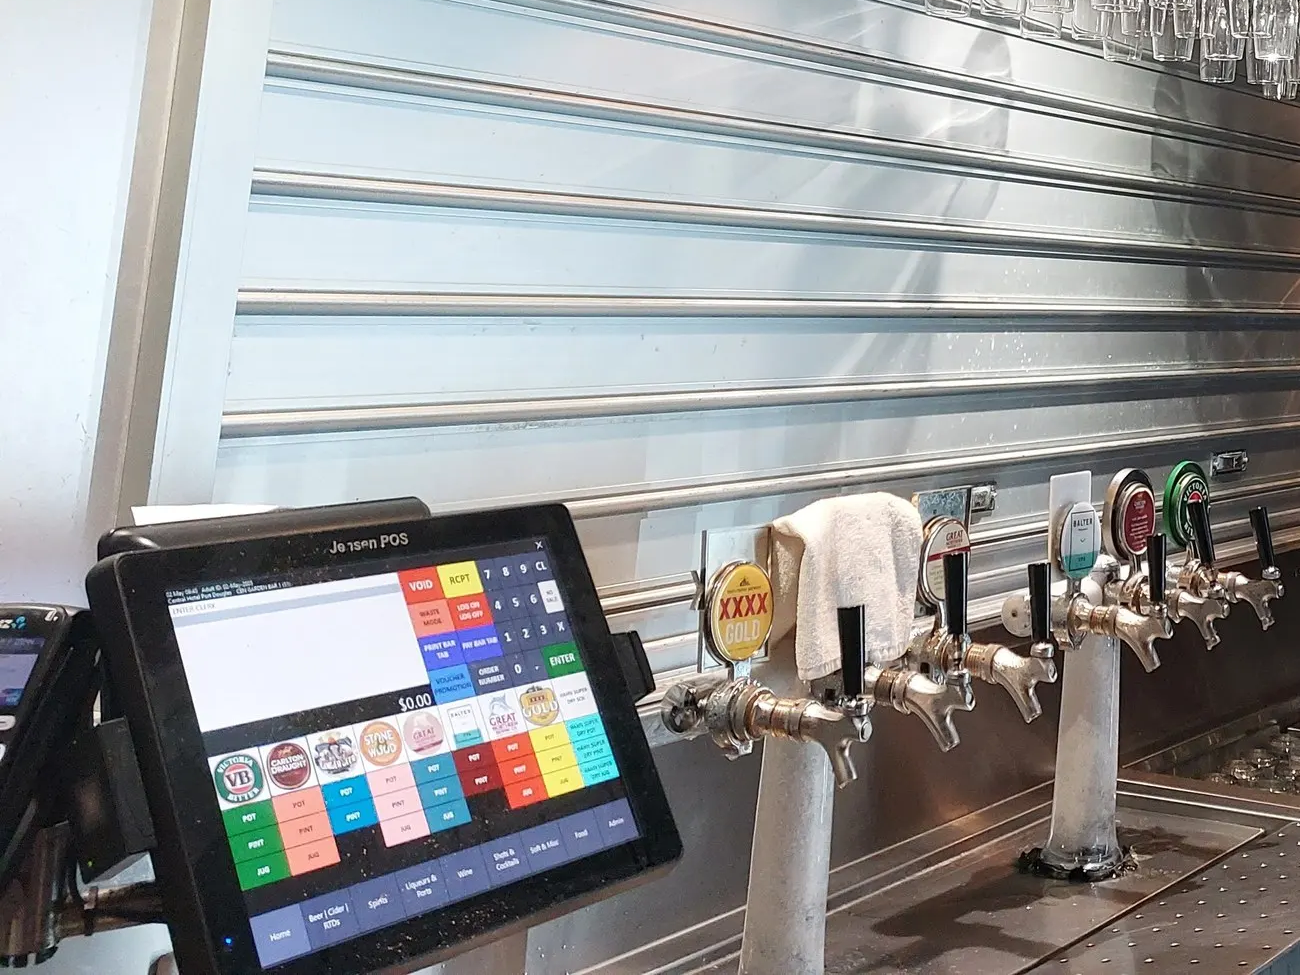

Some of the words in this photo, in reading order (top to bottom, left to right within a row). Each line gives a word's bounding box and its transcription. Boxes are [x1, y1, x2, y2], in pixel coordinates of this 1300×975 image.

[1073, 518, 1093, 527] BALTER
[380, 532, 409, 548] POS
[946, 529, 963, 541] GREAT
[484, 569, 490, 580] 7
[503, 566, 510, 577] 8
[520, 564, 527, 574] 9
[535, 561, 547, 571] CL
[450, 574, 471, 585] RCPT
[408, 579, 433, 592] VOID
[457, 603, 468, 612] LOG
[494, 600, 501, 610] 4
[512, 597, 520, 608] 5
[530, 594, 538, 604] 6
[719, 592, 768, 621] XXXX
[172, 605, 193, 615] ENTER
[419, 608, 440, 618] WASTE
[459, 612, 471, 621] LOG
[472, 610, 484, 619] OFF
[423, 617, 442, 627] MODE
[504, 632, 512, 642] 1
[522, 628, 530, 639] 2
[540, 625, 547, 635] 3
[557, 621, 565, 632] X
[726, 618, 760, 644] GOLD
[423, 643, 443, 653] PRINT
[442, 639, 456, 649] BAR
[462, 642, 474, 651] PAY
[474, 638, 487, 648] BAR
[487, 636, 499, 646] TAB
[437, 650, 450, 659] TAB
[549, 653, 576, 666] ENTER
[478, 666, 499, 676] ORDER
[514, 664, 522, 674] 0
[435, 673, 466, 685] VOUCHER
[478, 674, 505, 686] NUMBER
[435, 682, 472, 697] PROMOTION
[575, 687, 588, 697] SUPER
[398, 692, 432, 712] $0.00
[522, 700, 559, 717] GOLD
[489, 712, 517, 727] GREAT
[364, 729, 394, 744] STONE
[413, 727, 435, 741] GREAT
[507, 743, 519, 752] POT
[591, 740, 606, 749] SUPER
[367, 744, 397, 758] WOOD
[270, 753, 304, 767] CARLTON
[468, 753, 480, 762] POT
[551, 755, 563, 763] PINT
[217, 756, 253, 773] VICTORIA
[271, 760, 307, 775] DRAUGHT
[427, 764, 440, 773] POT
[598, 761, 613, 770] SUPER
[225, 770, 251, 787] VB
[385, 775, 397, 784] POT
[226, 787, 260, 802] BITTER
[339, 787, 353, 797] POT
[434, 787, 448, 797] PINT
[292, 800, 306, 809] POT
[392, 800, 405, 808] PINT
[241, 812, 257, 823] POT
[345, 811, 361, 822] PINT
[608, 817, 624, 828] Admin
[299, 825, 313, 834] PINT
[401, 824, 411, 833] JUG
[574, 829, 589, 839] Food
[248, 838, 265, 849] PINT
[493, 850, 509, 861] Shots
[529, 845, 541, 855] Soft
[307, 852, 320, 861] JUG
[496, 858, 520, 871] Cocktails
[257, 865, 271, 876] JUG
[457, 868, 473, 879] Wine
[405, 876, 431, 891] Liqueurs
[430, 873, 438, 882] &
[416, 888, 432, 898] Ports
[368, 896, 388, 910] Spirits
[308, 912, 324, 923] Beer
[327, 905, 345, 917] Cider
[323, 918, 341, 930] RTDs
[269, 929, 291, 942] Home
